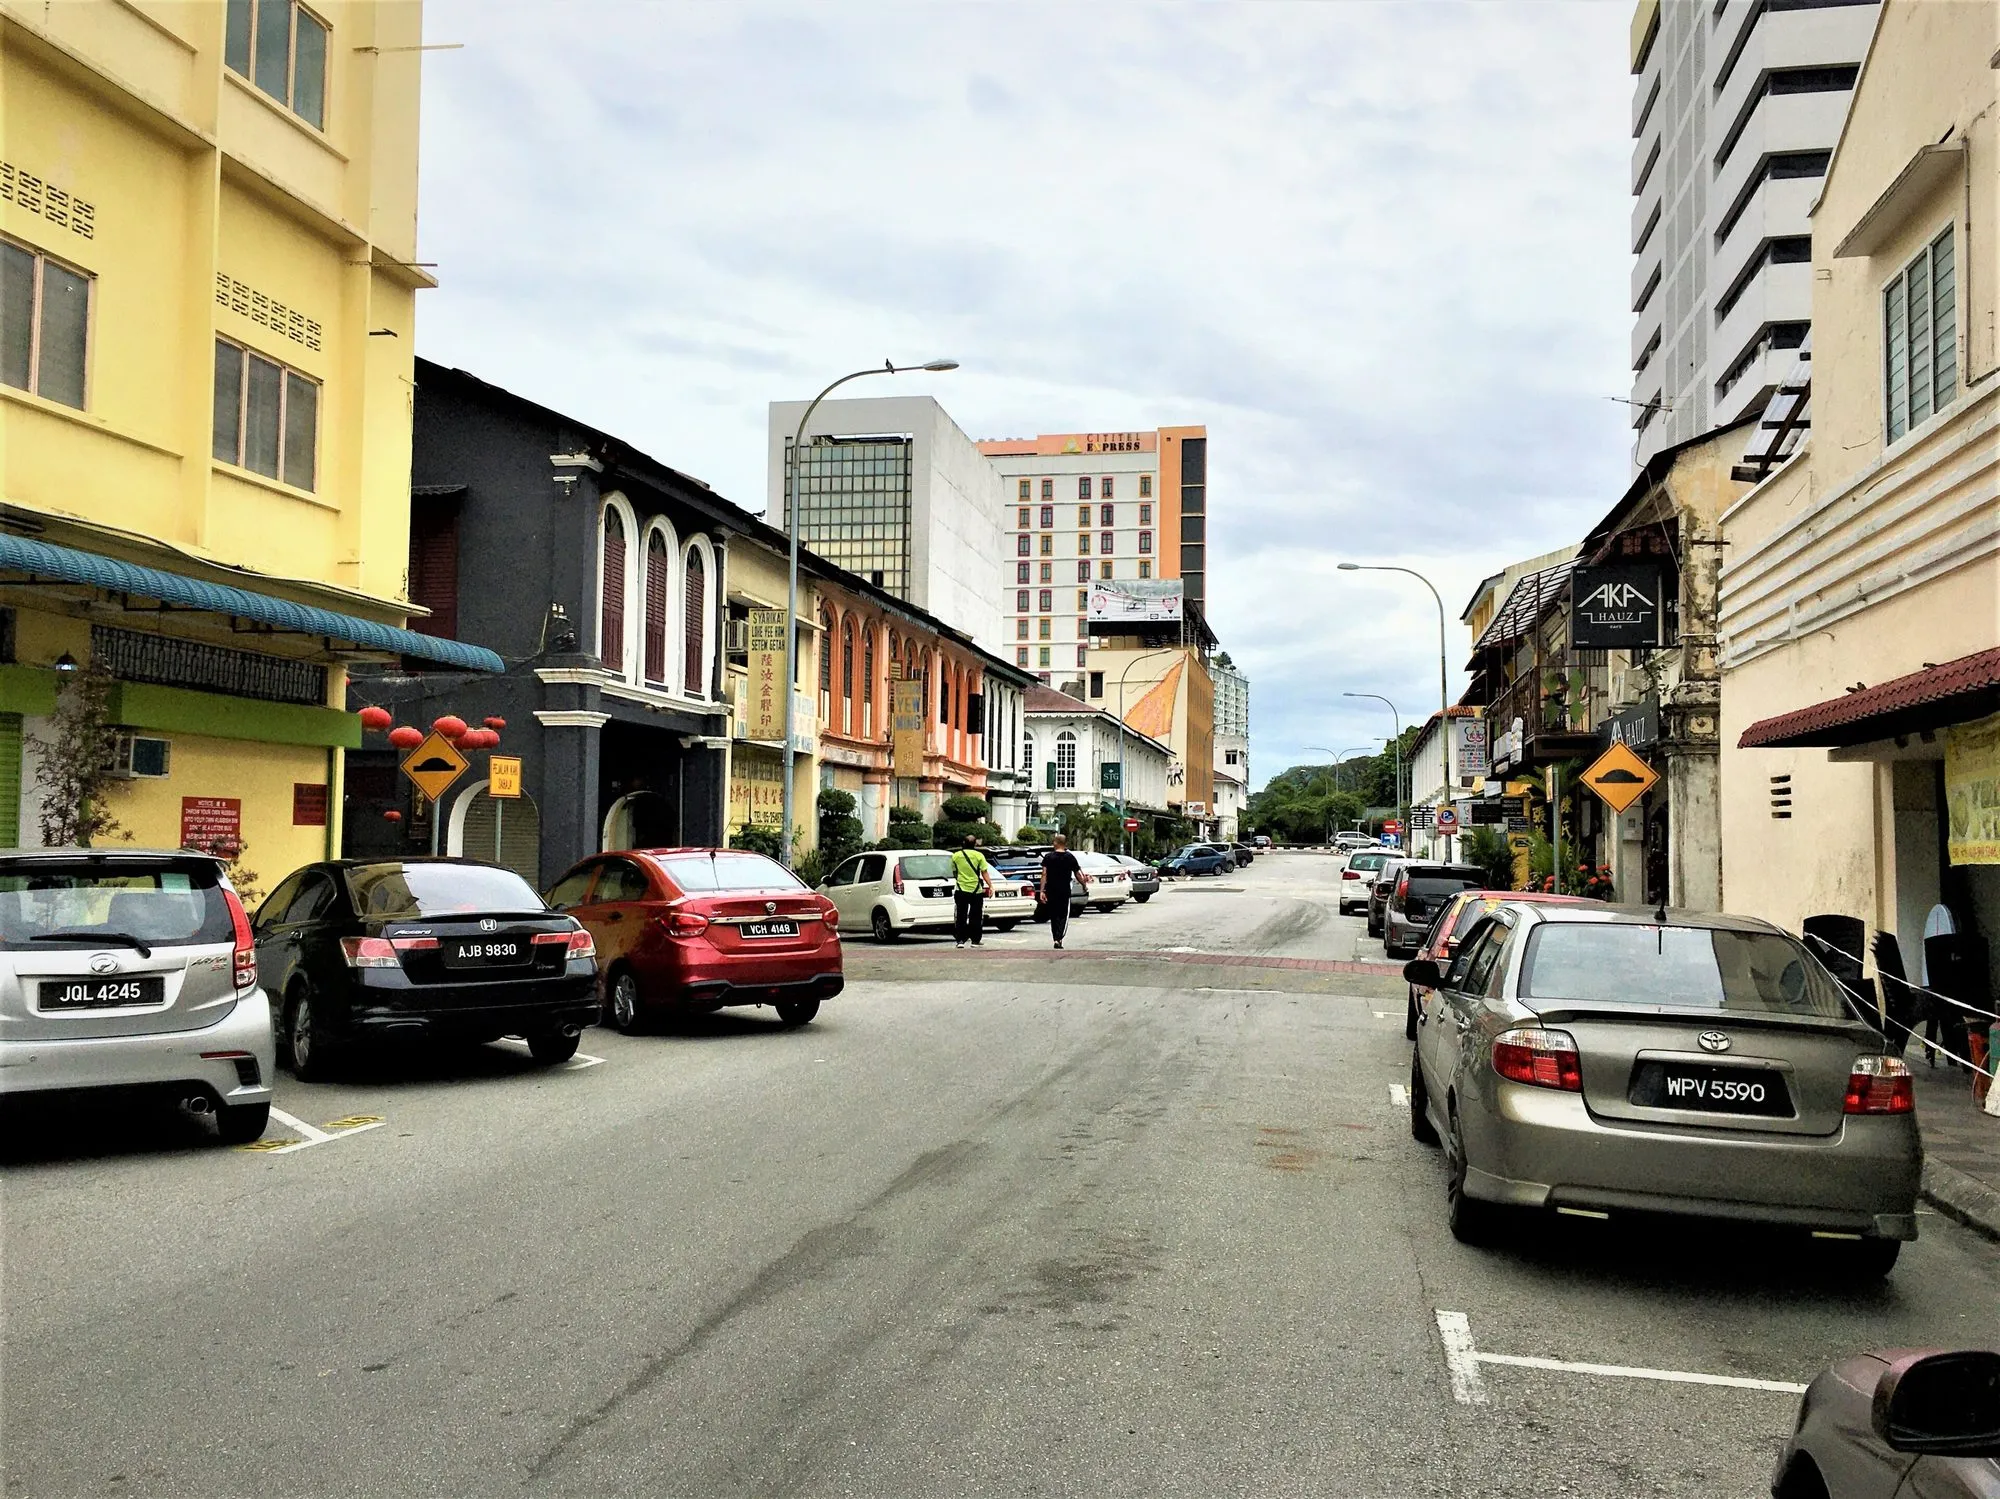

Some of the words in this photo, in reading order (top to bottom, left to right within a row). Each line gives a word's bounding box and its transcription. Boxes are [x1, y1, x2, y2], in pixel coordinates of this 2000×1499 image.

[1086, 432, 1140, 443] CITITEL
[1086, 442, 1141, 452] EXPRESS
[1577, 583, 1655, 608] AKA
[752, 612, 785, 625] SYARIKAT
[1599, 612, 1634, 621] HAUZ
[751, 639, 768, 651] SETEM
[769, 639, 785, 651] GETAH
[896, 696, 921, 713] YEW
[896, 714, 921, 731] MING
[1625, 717, 1646, 747] HAUZ
[1103, 772, 1119, 780] STG
[1411, 805, 1436, 830] 董
[393, 928, 433, 936] Accord
[750, 924, 768, 935] VCH
[770, 923, 791, 934] 4148
[458, 945, 482, 958] AJB
[485, 943, 517, 956] 9830
[59, 985, 94, 1002] JQL
[96, 982, 141, 1001] 4245
[1666, 1076, 1707, 1098] WPV
[1709, 1080, 1766, 1103] 5590
